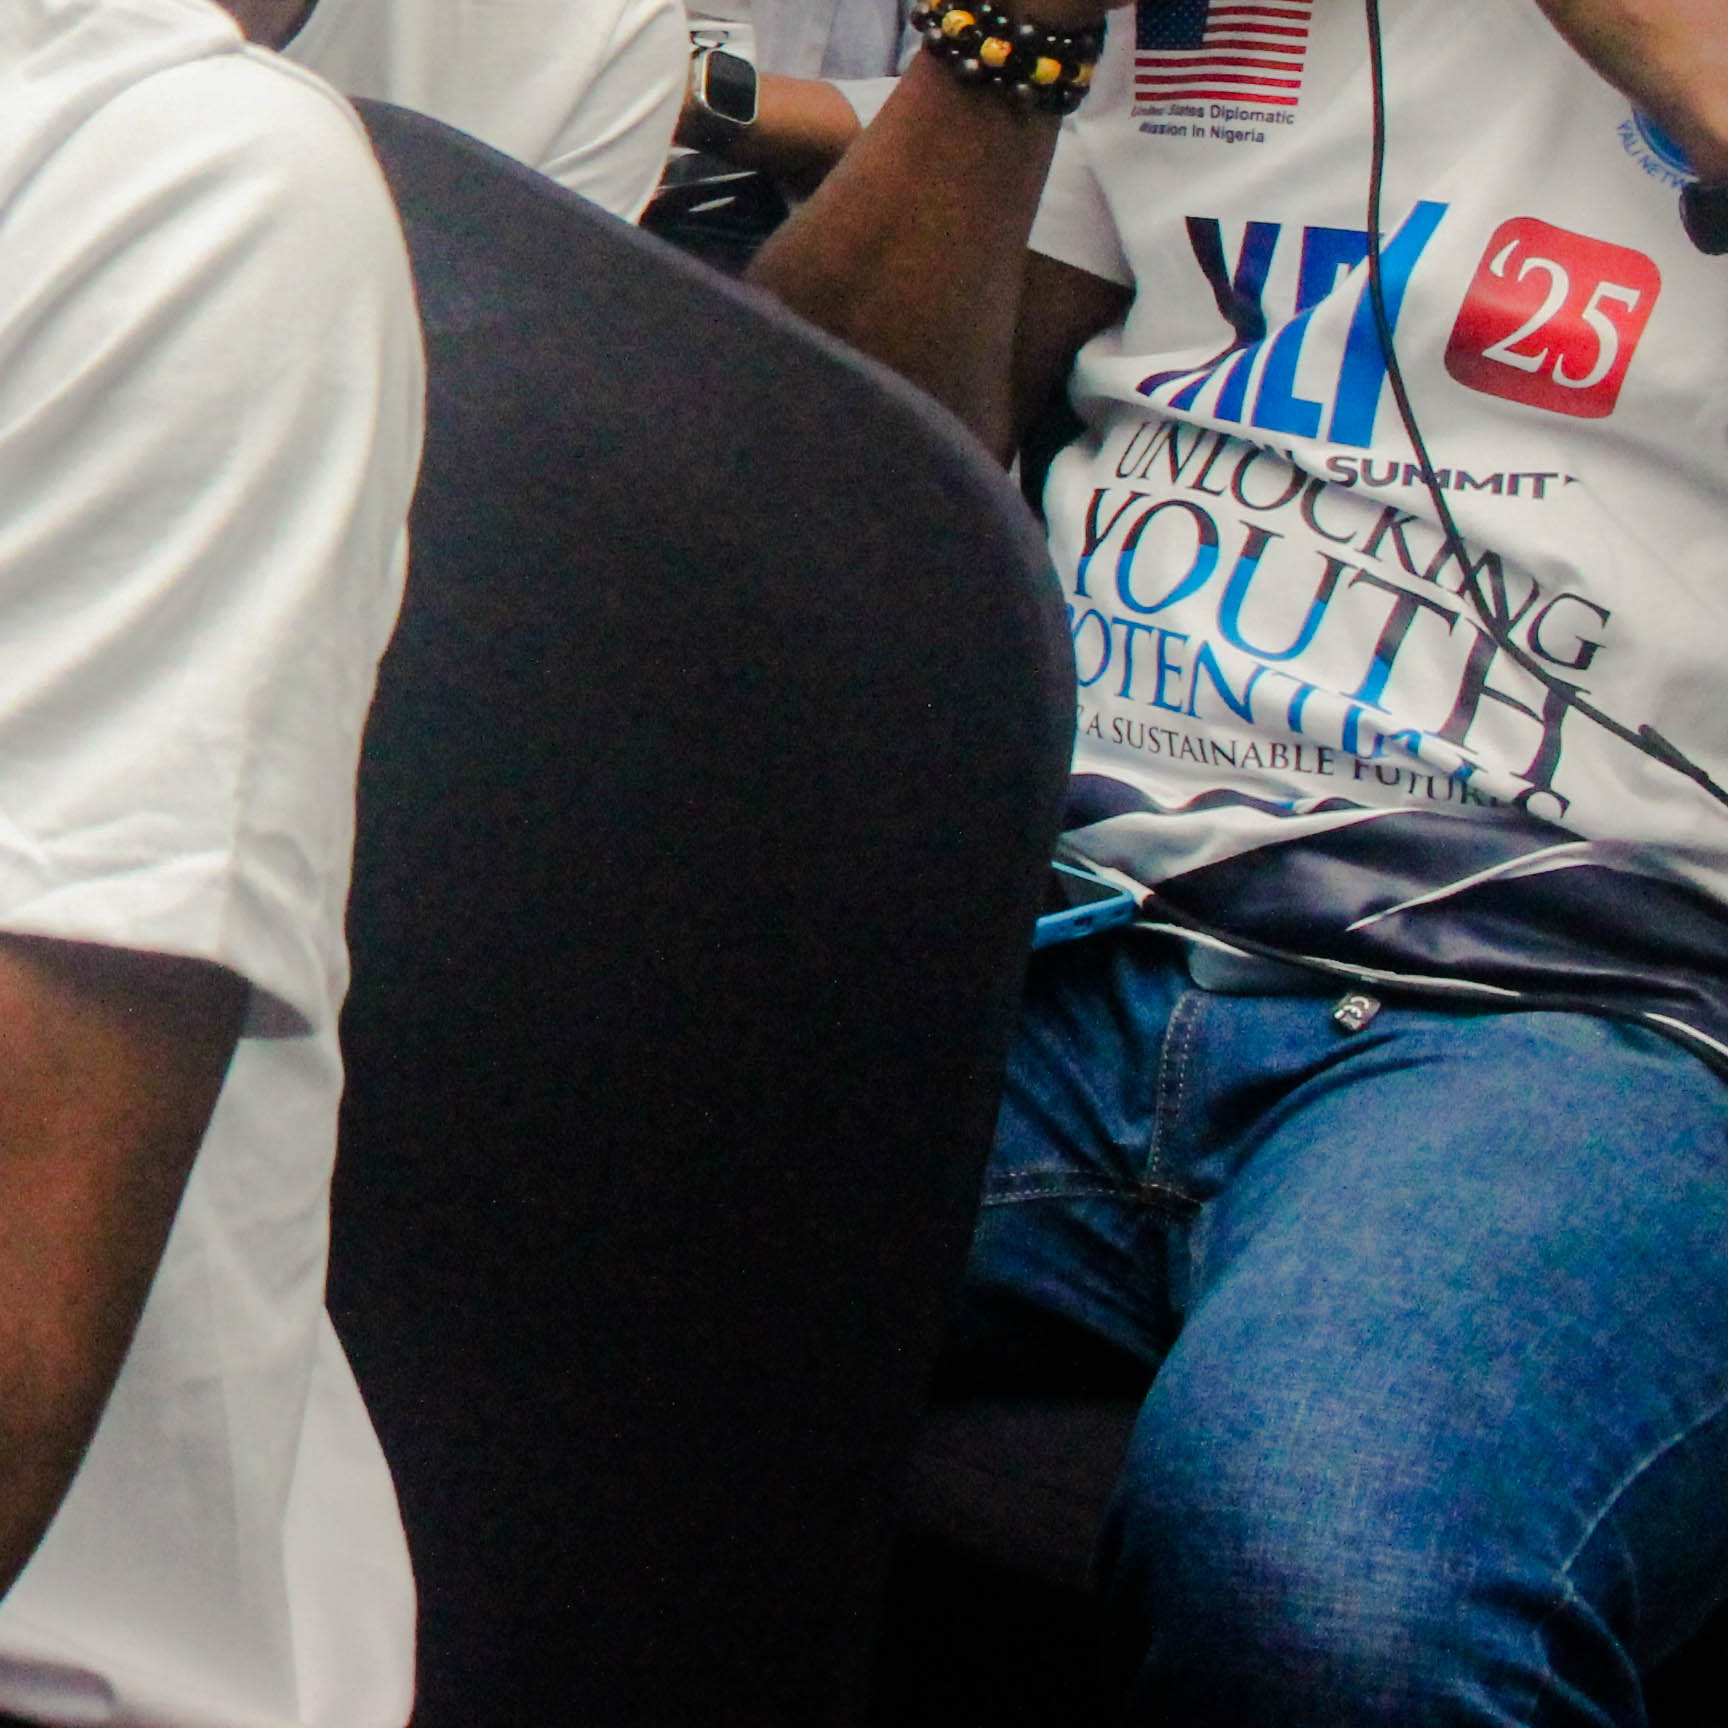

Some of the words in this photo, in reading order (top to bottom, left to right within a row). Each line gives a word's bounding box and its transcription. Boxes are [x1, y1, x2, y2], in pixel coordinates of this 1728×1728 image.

[1210, 104, 1296, 125] Diplomatic
[1210, 125, 1265, 144] Nigeria
[1482, 239, 1642, 390] '25
[1326, 455, 1560, 500] SUMMIT
[1074, 489, 1591, 792] YOUTH
[1084, 717, 1104, 740] A
[1112, 715, 1336, 776] SUSTAINABLE
